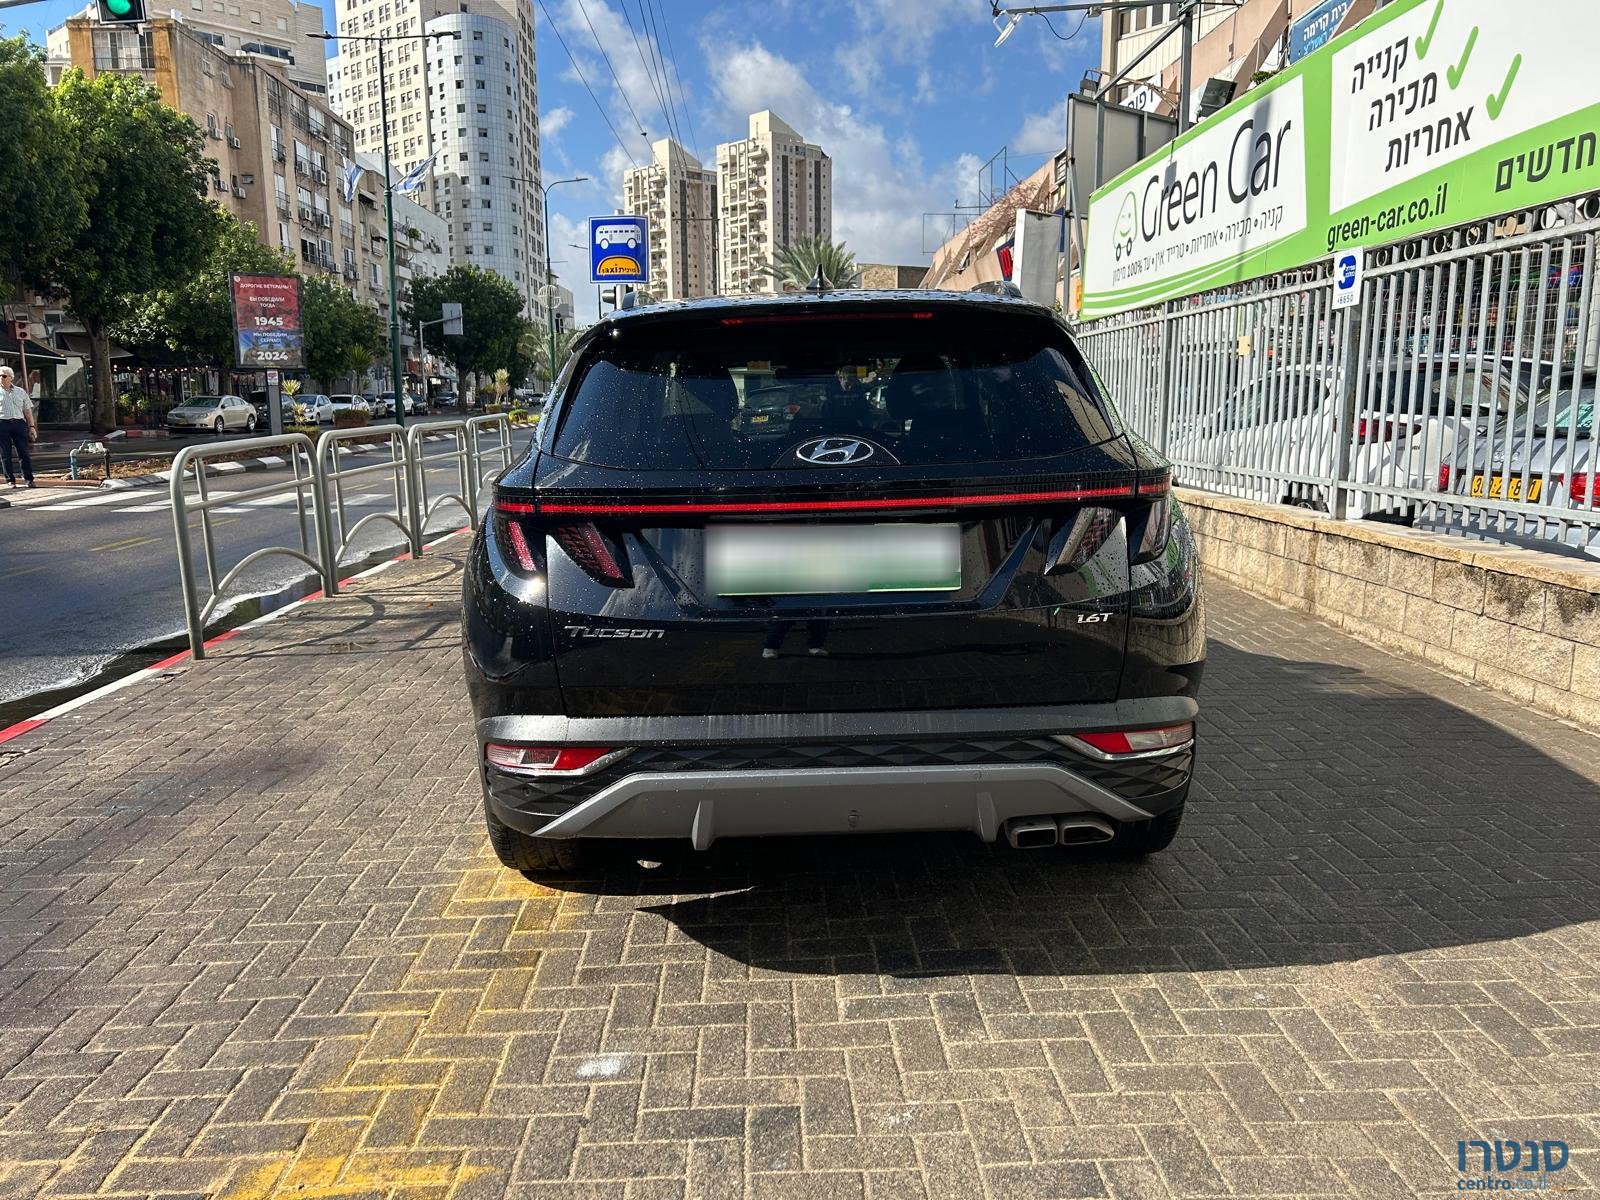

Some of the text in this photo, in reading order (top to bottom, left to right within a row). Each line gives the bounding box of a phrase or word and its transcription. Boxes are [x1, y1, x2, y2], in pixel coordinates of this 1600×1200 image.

[1351, 36, 1409, 94] קנייה
[1368, 71, 1438, 131] מכירה
[1384, 105, 1474, 172] אחריות
[1494, 131, 1597, 193] חדשים
[1141, 118, 1292, 242] Green Car
[1327, 182, 1448, 252] green-car.co.il
[254, 316, 284, 326] 1945
[257, 351, 289, 361] 2024
